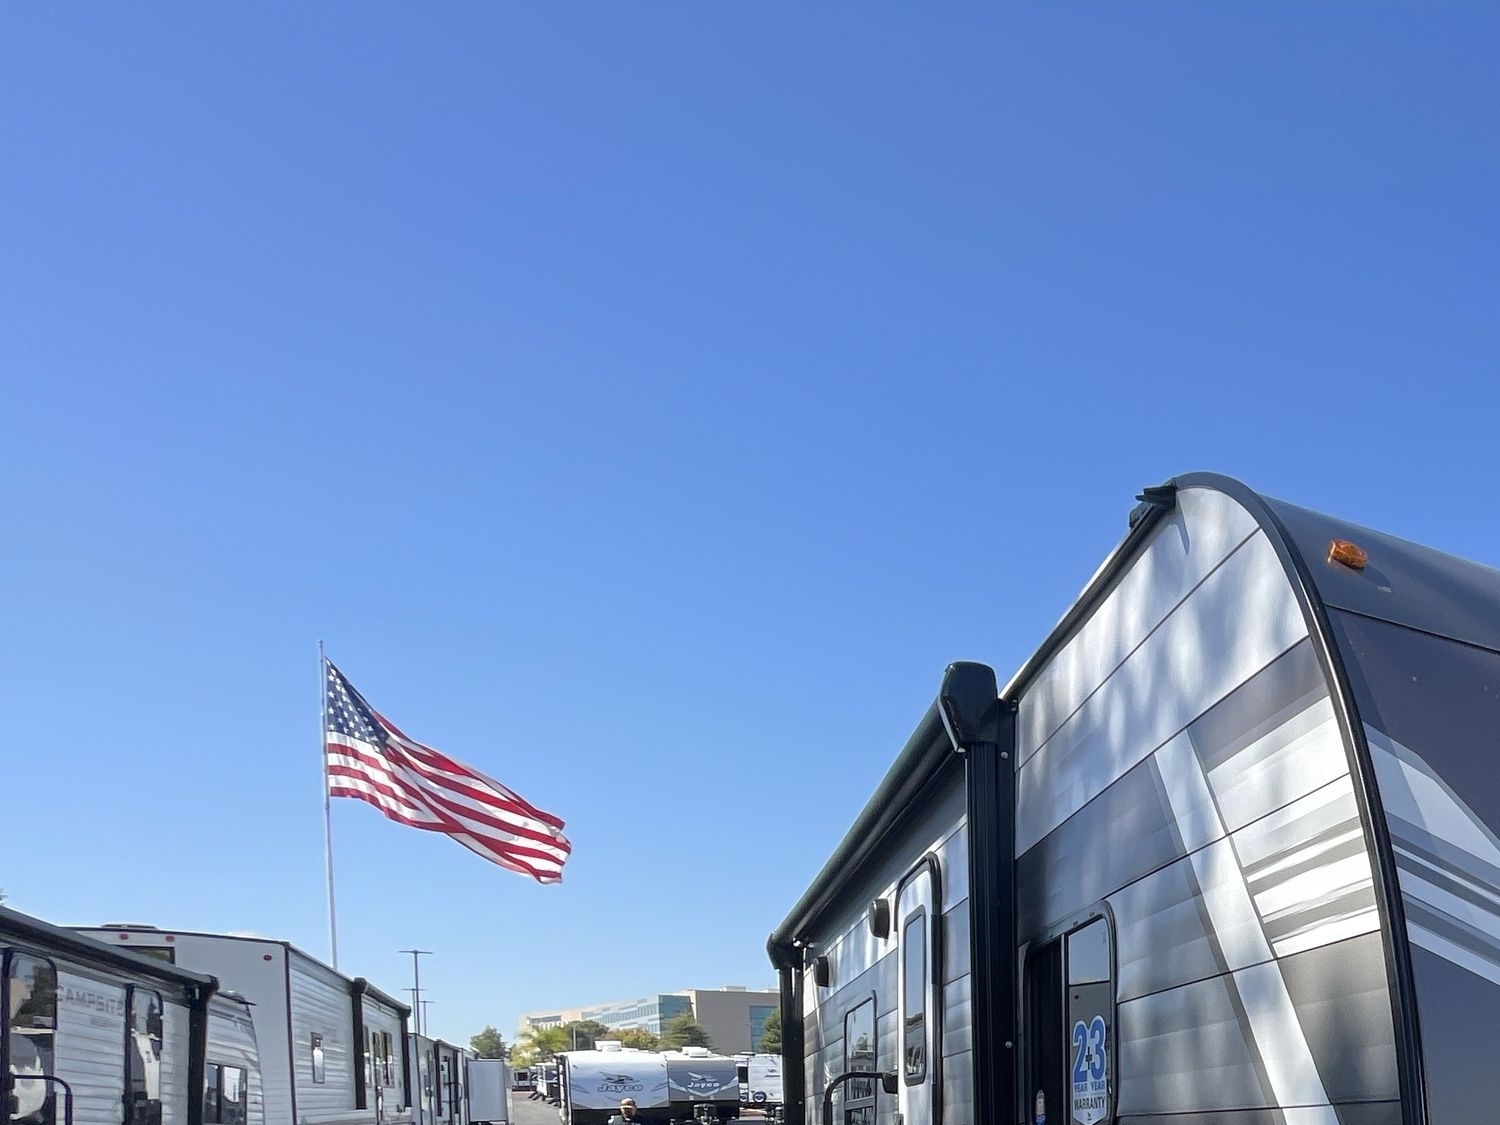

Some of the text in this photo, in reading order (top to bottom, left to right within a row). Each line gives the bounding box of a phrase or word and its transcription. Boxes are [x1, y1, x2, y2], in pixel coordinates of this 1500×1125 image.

[598, 1083, 643, 1093] Jayco
[687, 1081, 720, 1091] Jayco
[1075, 1081, 1105, 1093] YEAR YEAR
[1074, 1096, 1106, 1111] WARRANTY
